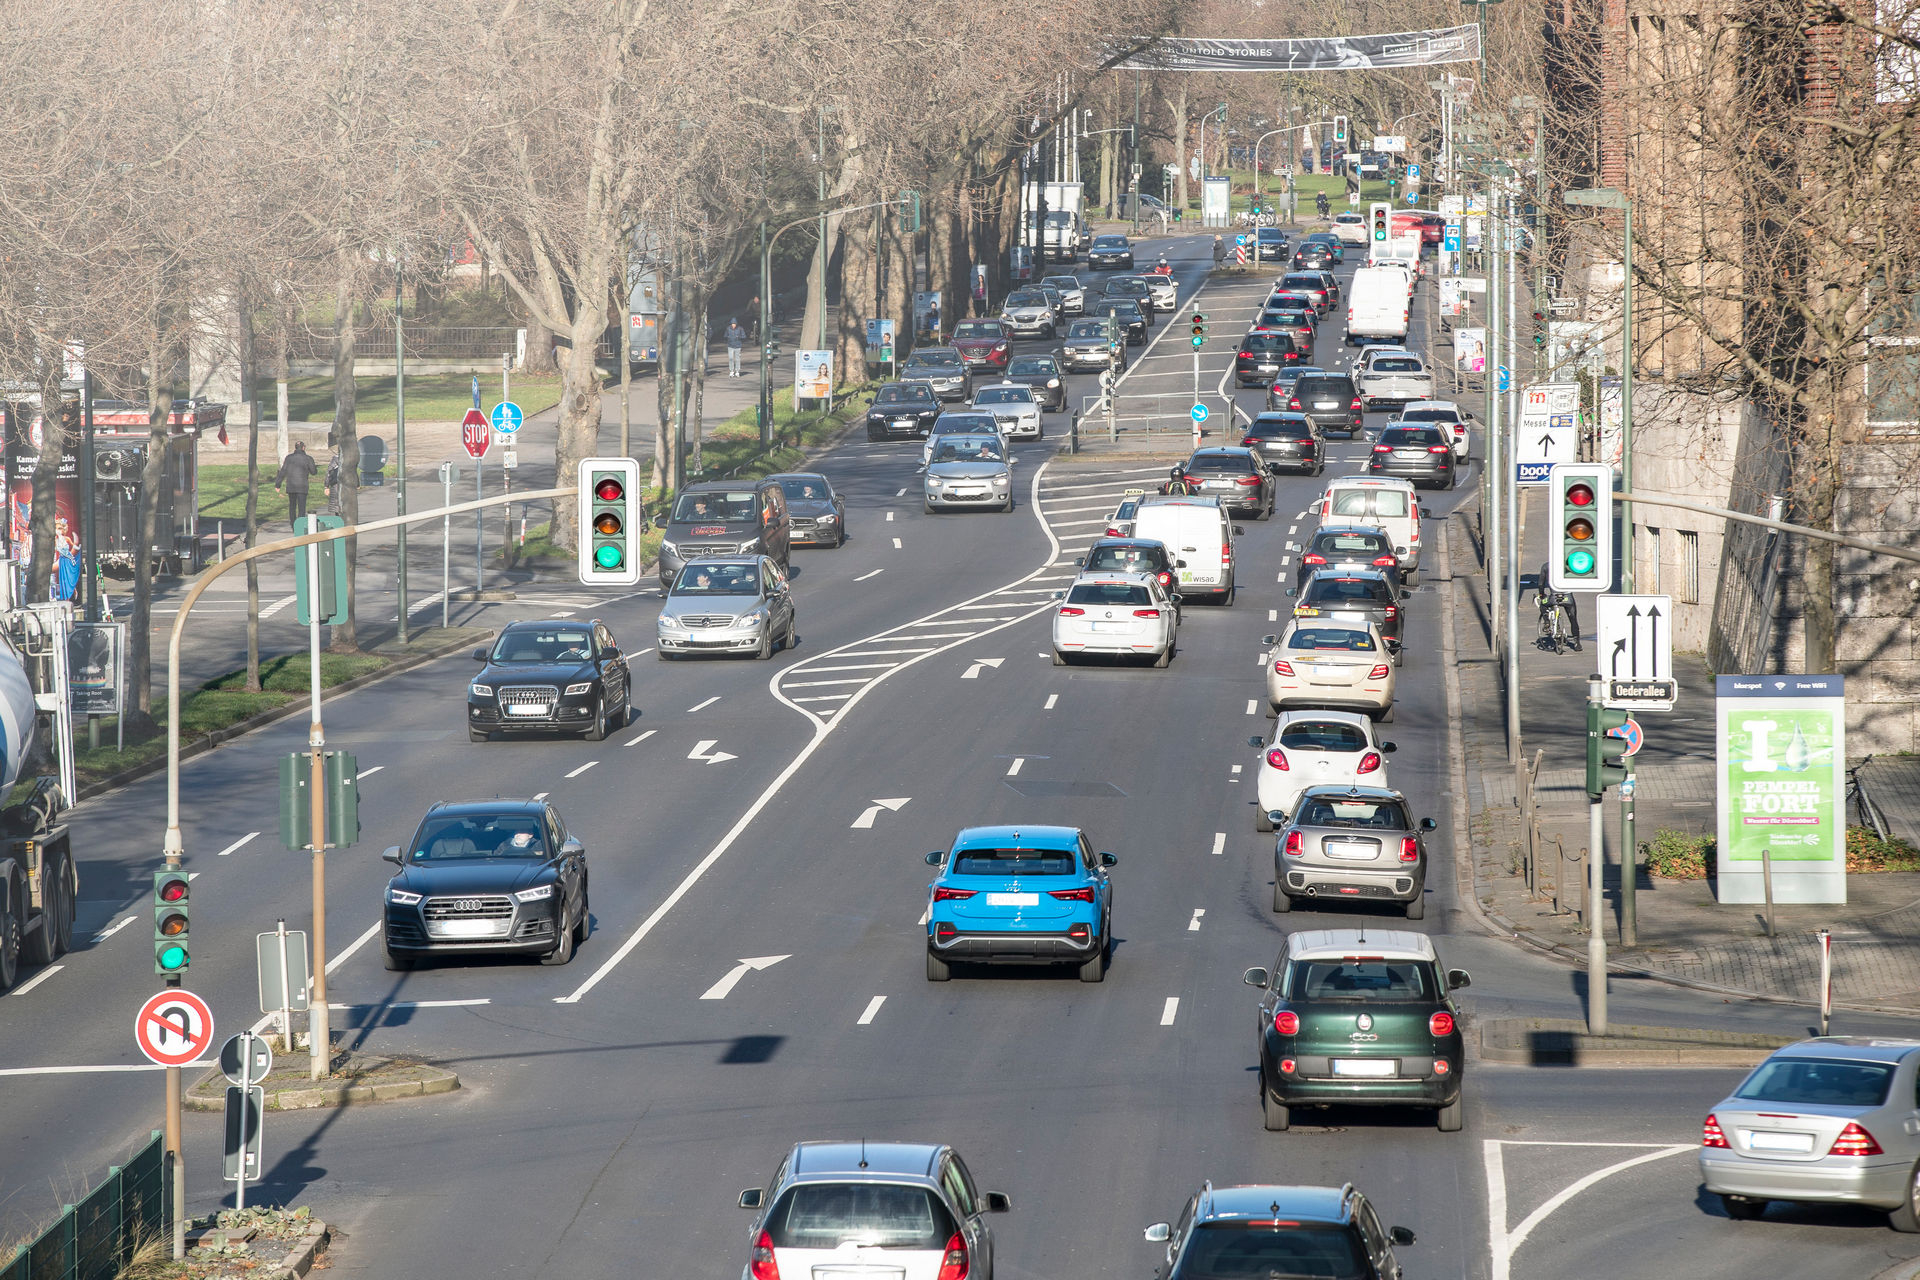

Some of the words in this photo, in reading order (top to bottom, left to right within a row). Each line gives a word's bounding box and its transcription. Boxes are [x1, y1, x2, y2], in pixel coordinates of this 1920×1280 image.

[1181, 47, 1225, 56] UNTOLD
[1228, 48, 1273, 57] STORIES
[464, 424, 488, 444] STOP
[1520, 464, 1549, 476] boot
[1616, 685, 1665, 697] Oederallee
[1733, 682, 1762, 690] bluespot
[1742, 720, 1778, 772] I
[1742, 781, 1820, 793] PEMPEL
[1742, 793, 1820, 814] FORT
